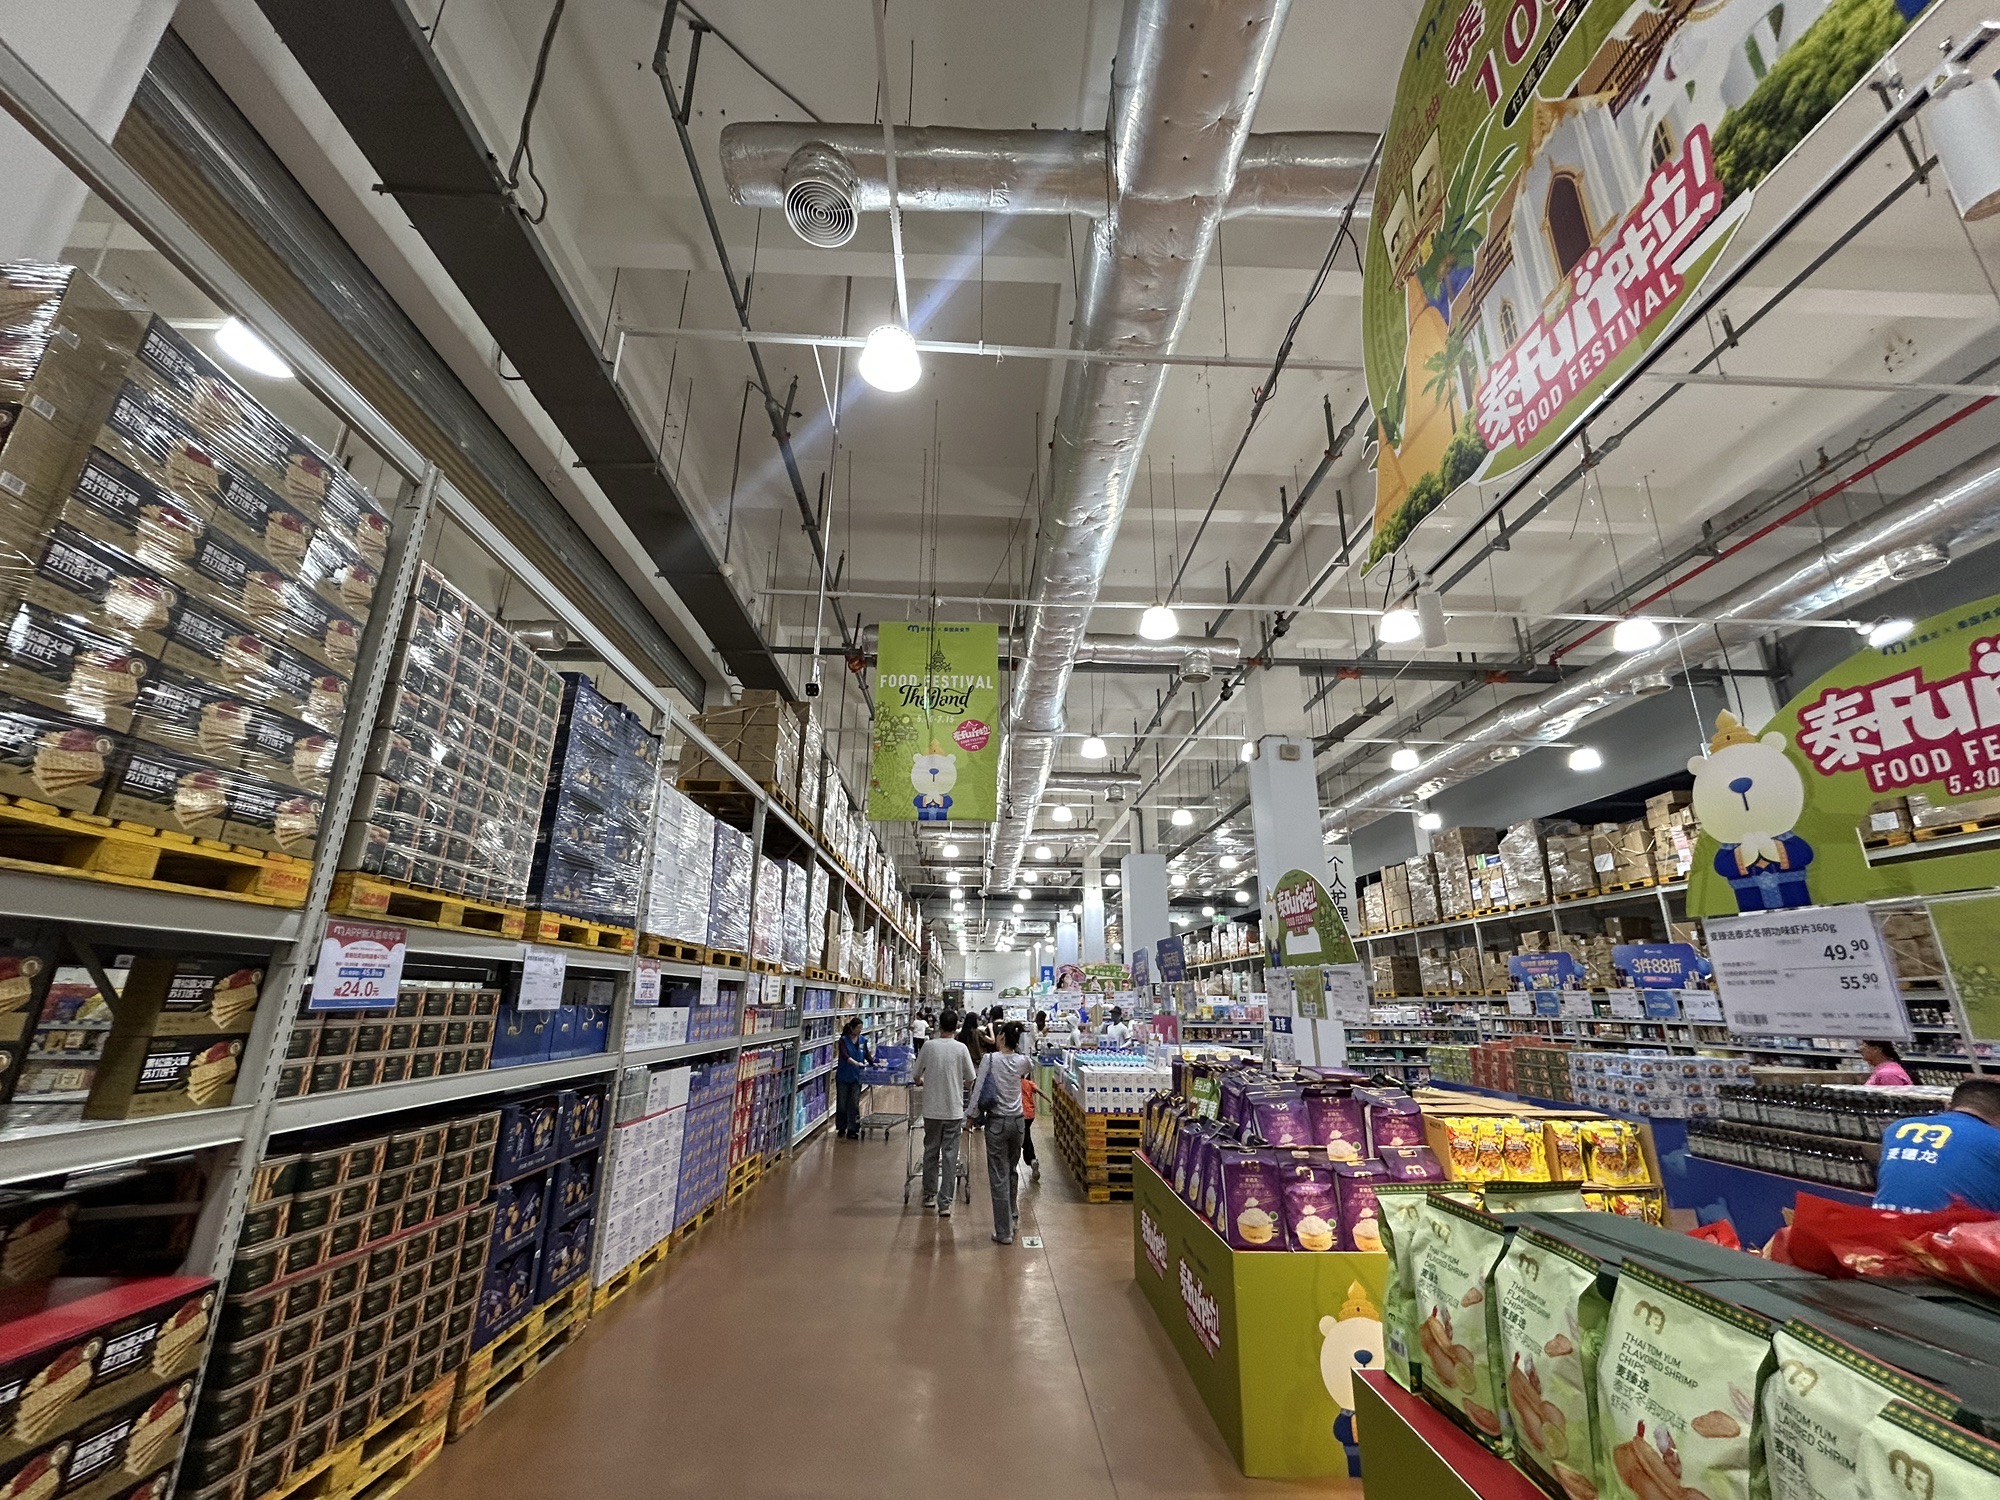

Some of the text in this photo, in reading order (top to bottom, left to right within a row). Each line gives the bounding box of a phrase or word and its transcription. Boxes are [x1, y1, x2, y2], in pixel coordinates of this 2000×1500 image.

[1516, 272, 1678, 443] FOOD FESTIVAL
[880, 674, 994, 689] FOOD FESTIVAL
[1871, 749, 1952, 786] FOOD
[1823, 938, 1869, 961] 49.90
[1840, 972, 1878, 990] 55.90
[1503, 1296, 1525, 1315] CHIPS
[1625, 1331, 1646, 1351] THAI
[1663, 1352, 1682, 1369] YUM
[1618, 1352, 1647, 1375] CHIPS
[1621, 1342, 1699, 1390] FLAVORED SHRIMP
